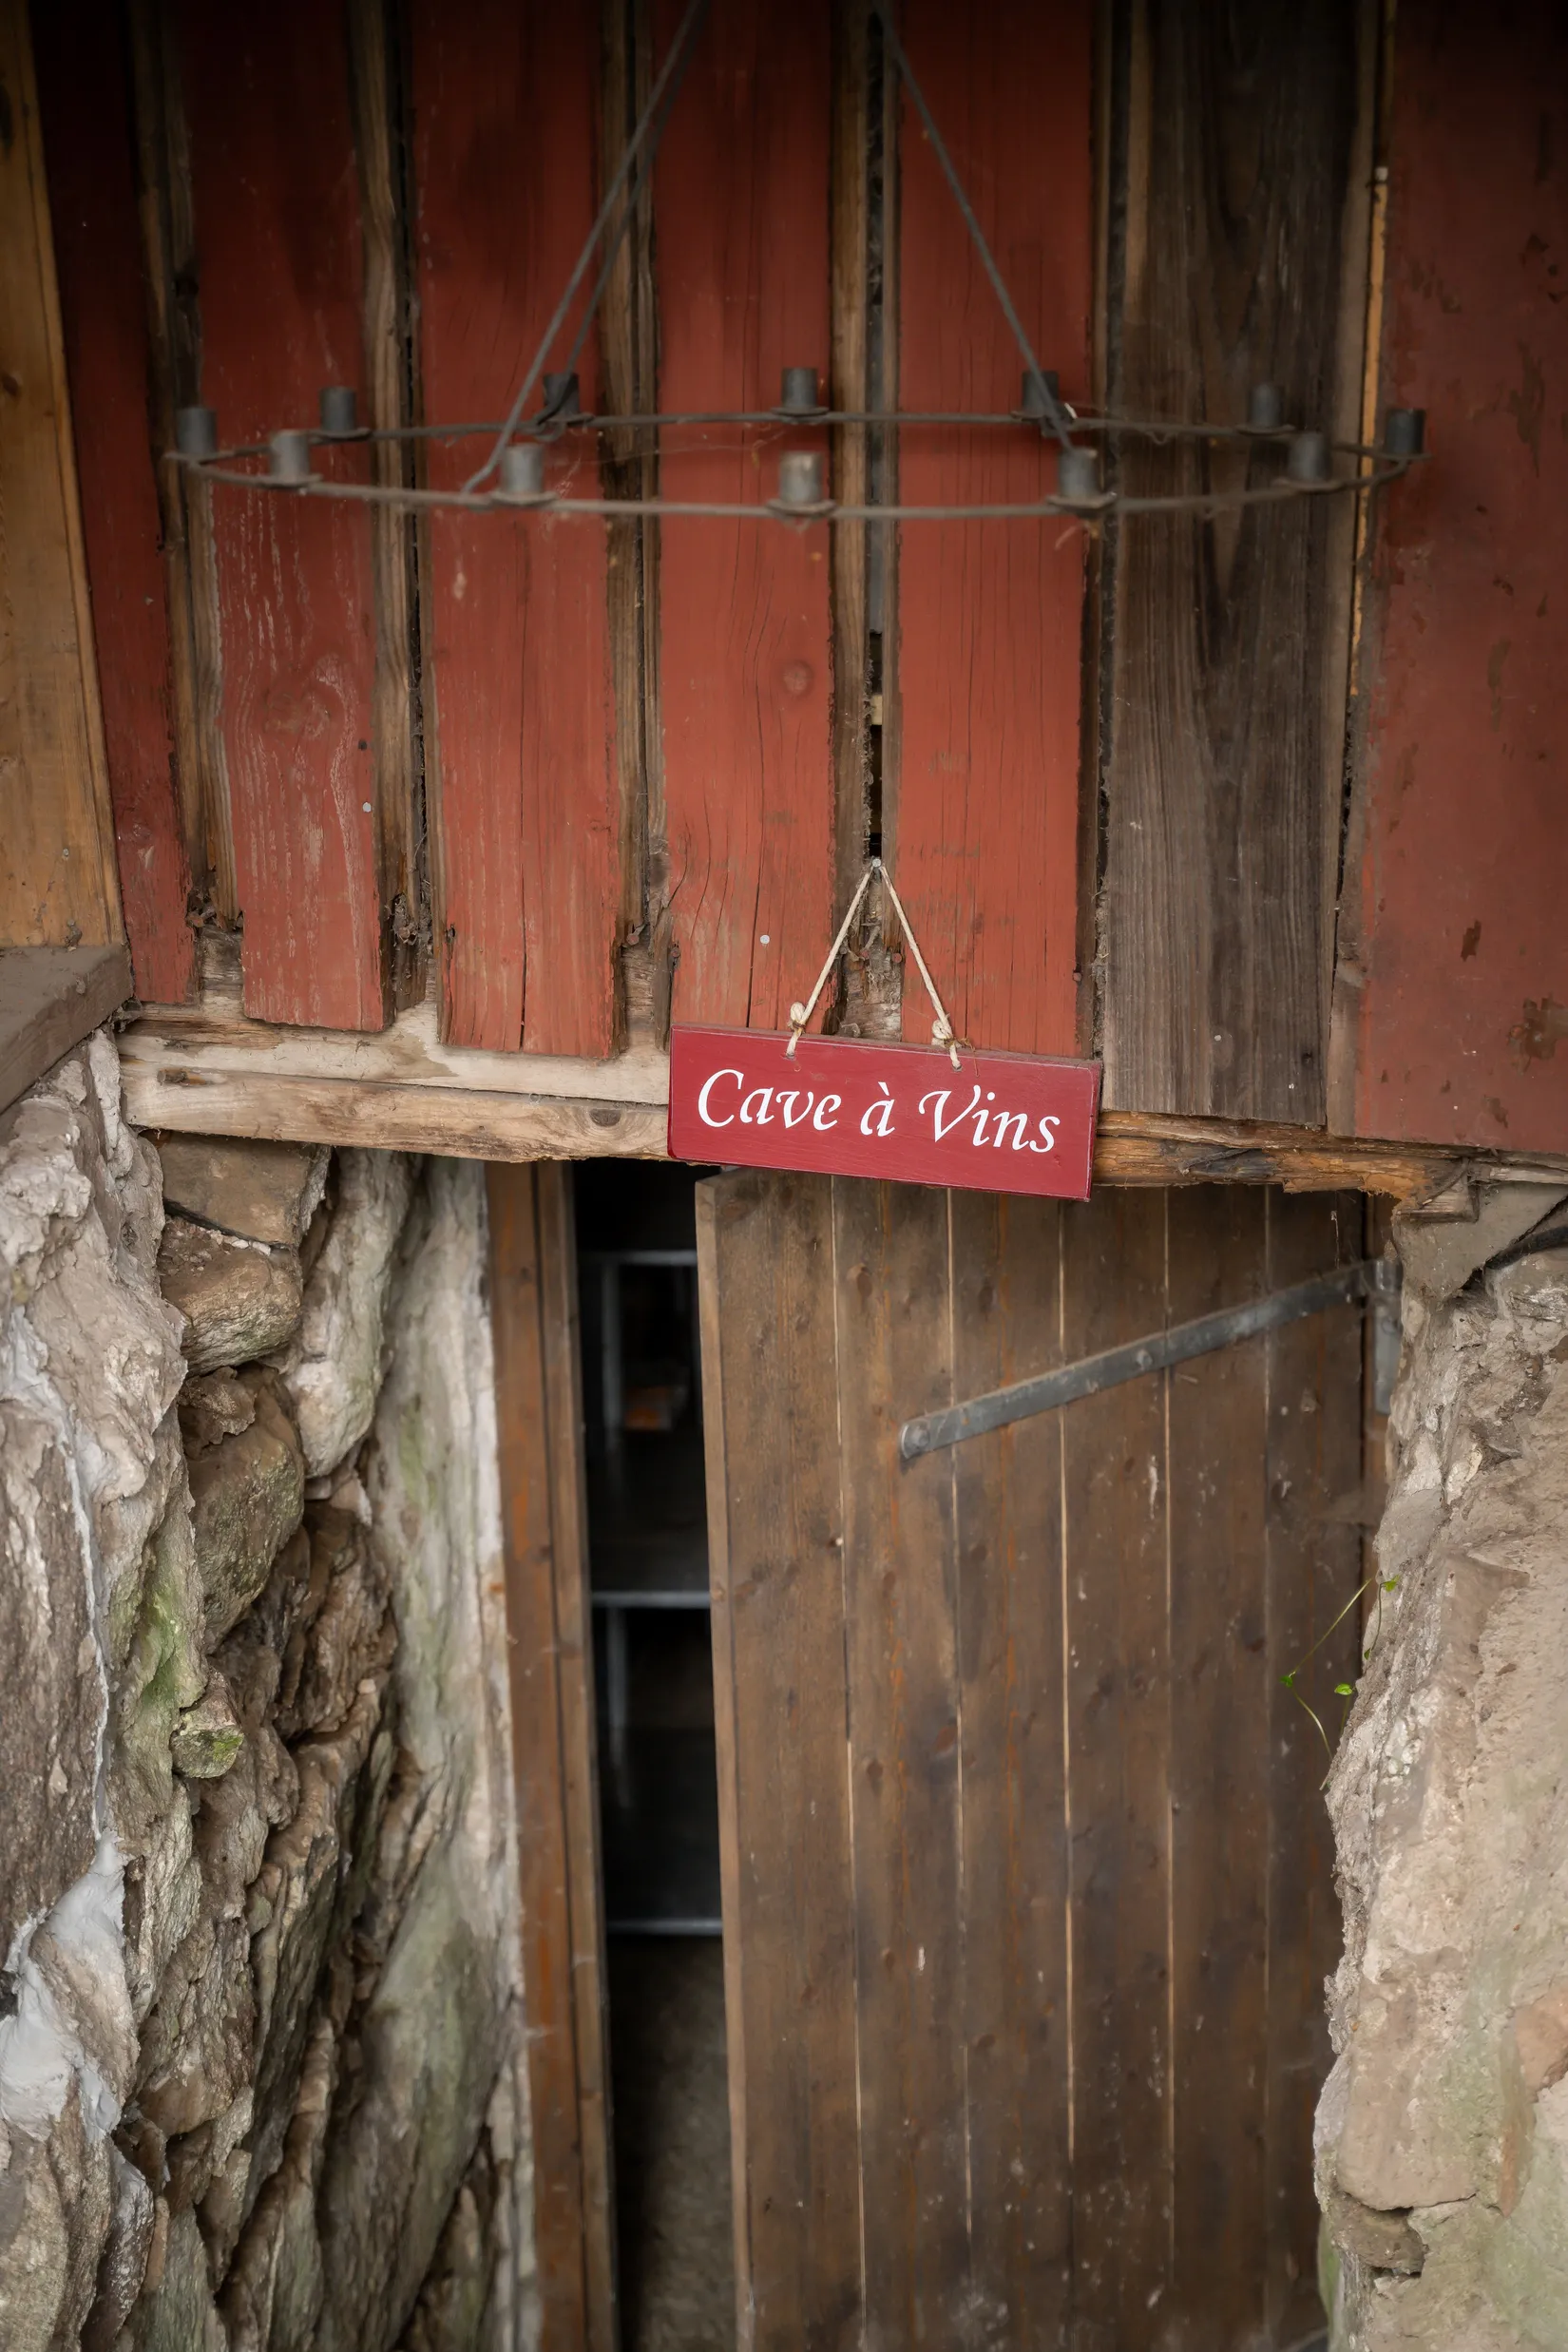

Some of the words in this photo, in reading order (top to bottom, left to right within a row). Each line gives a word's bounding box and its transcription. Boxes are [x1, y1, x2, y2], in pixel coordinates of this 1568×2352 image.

[698, 1068, 842, 1131] Cave
[859, 1080, 896, 1138] à
[918, 1084, 1061, 1154] Vins
